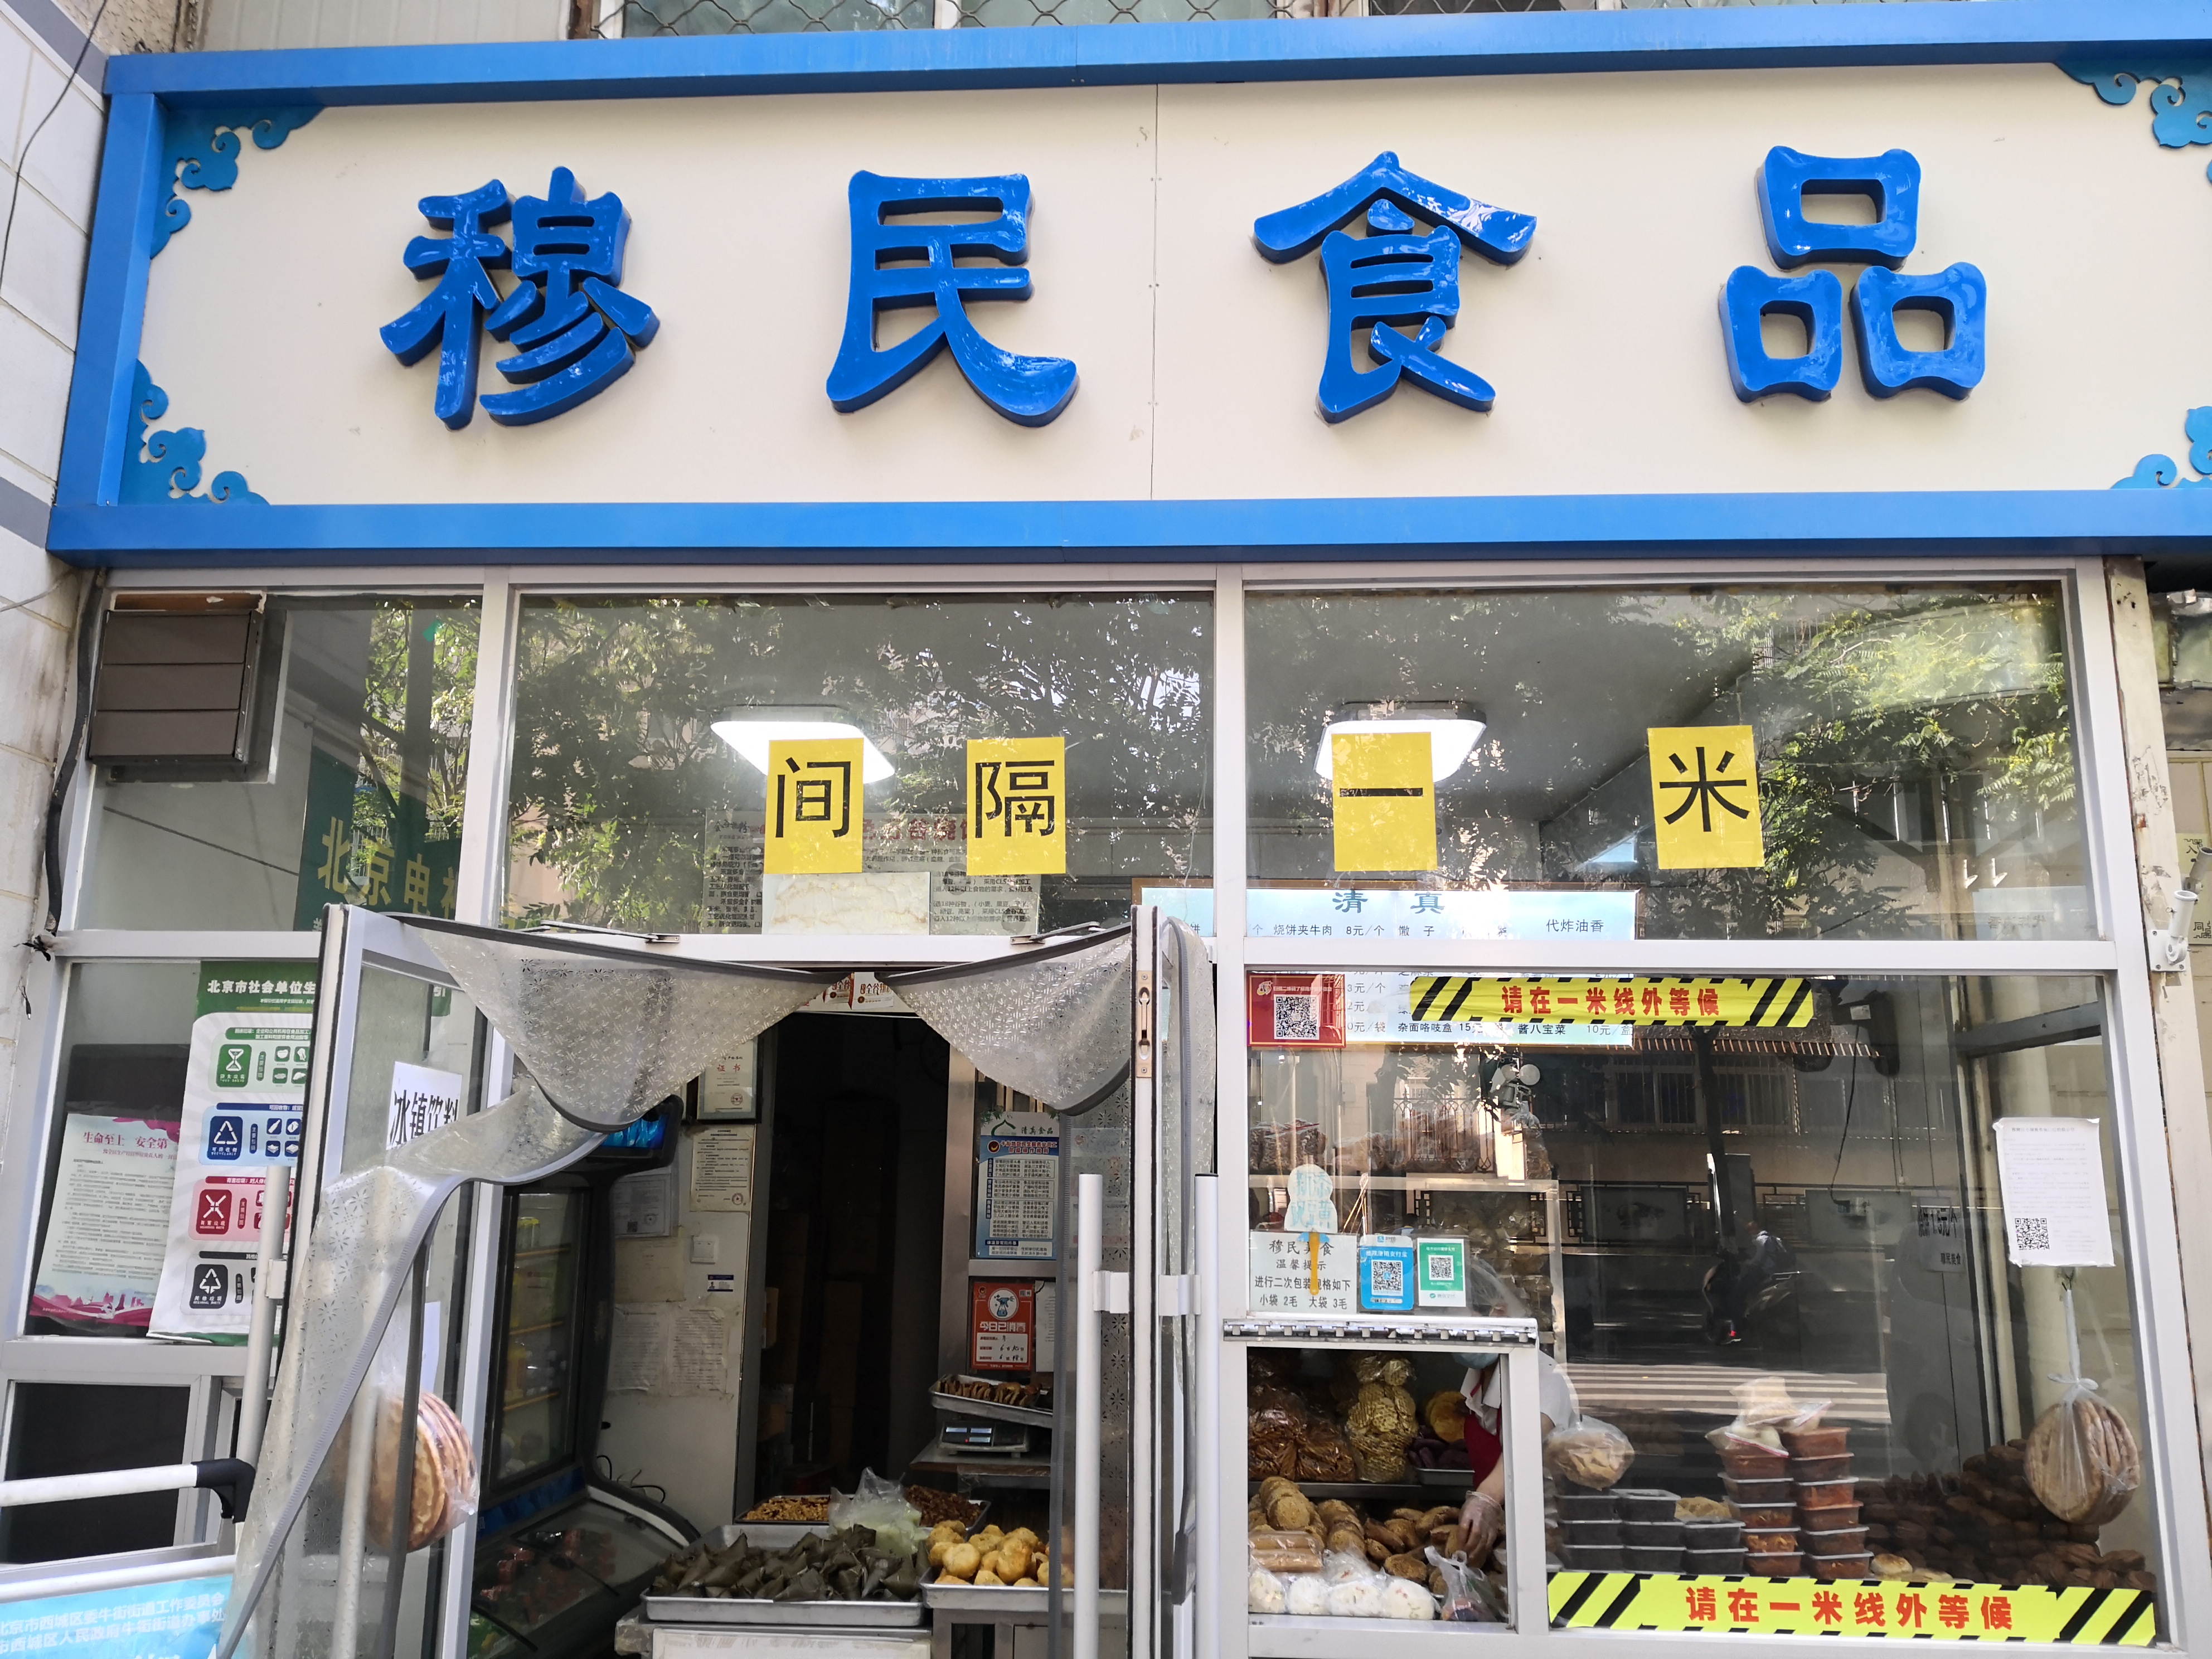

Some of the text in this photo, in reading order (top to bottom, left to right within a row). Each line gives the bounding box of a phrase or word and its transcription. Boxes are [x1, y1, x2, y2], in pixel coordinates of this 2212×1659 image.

[379, 144, 1988, 431] 穆民食品
[1332, 890, 1445, 914] 清真
[1274, 924, 1332, 936] 烧饼夹牛肉
[1346, 924, 1384, 937] 8元/个
[1546, 918, 1604, 933] 代炸油香
[207, 979, 316, 995] 北京市社会单位生
[1347, 983, 1386, 993] 3元/个
[1502, 986, 1720, 1017] 请在一米线外等候
[1518, 1023, 1566, 1035] 酱八宝菜
[1587, 1025, 1633, 1036] 10元/盒
[717, 1063, 741, 1073] 证书
[1021, 1126, 1054, 1135] 清真食品
[83, 1131, 168, 1149] 生命至上 安全第
[1275, 1259, 1327, 1271] 温馨提示
[1260, 1294, 1347, 1310] 小袋 2毛 大袋 3毛
[1685, 1586, 2014, 1632] 请在一米线外等候
